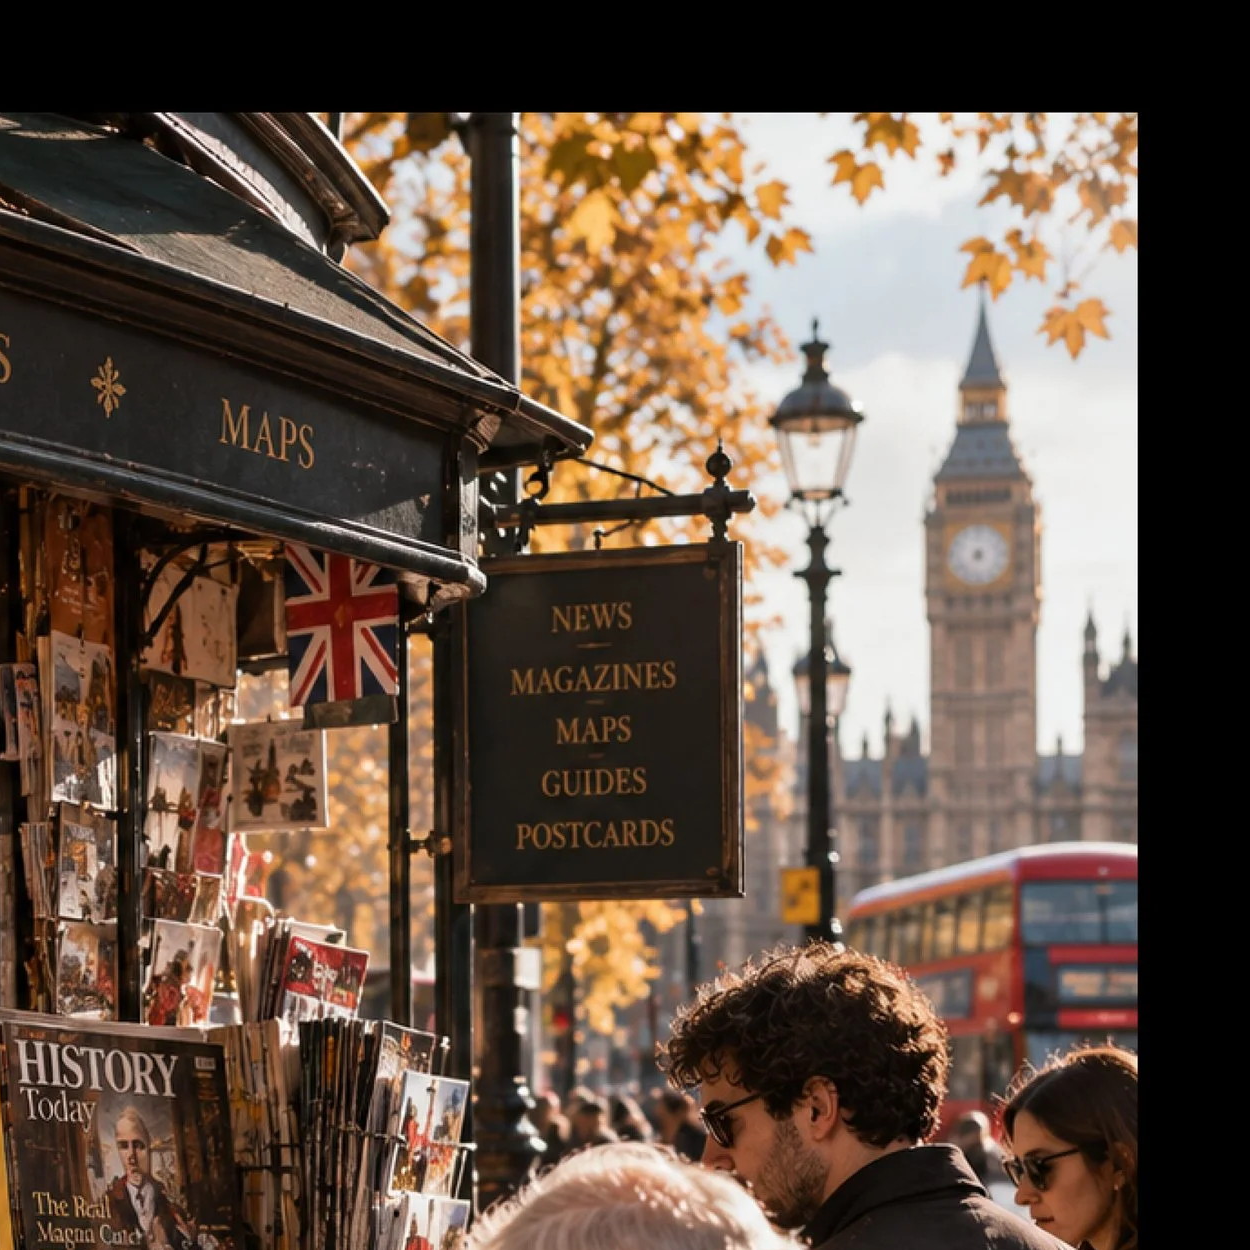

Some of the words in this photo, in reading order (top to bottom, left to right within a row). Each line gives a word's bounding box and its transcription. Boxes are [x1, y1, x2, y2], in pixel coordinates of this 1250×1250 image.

[219, 398, 315, 470] MAPS
[552, 601, 633, 633] NEWS
[510, 660, 677, 695] MAGAZINES
[556, 715, 632, 744] MAPS
[541, 767, 647, 797] GUIDES
[515, 819, 675, 850] POSTCARDS
[15, 1038, 179, 1098] HISTORY
[20, 1087, 97, 1132] Today
[32, 1191, 69, 1216] The
